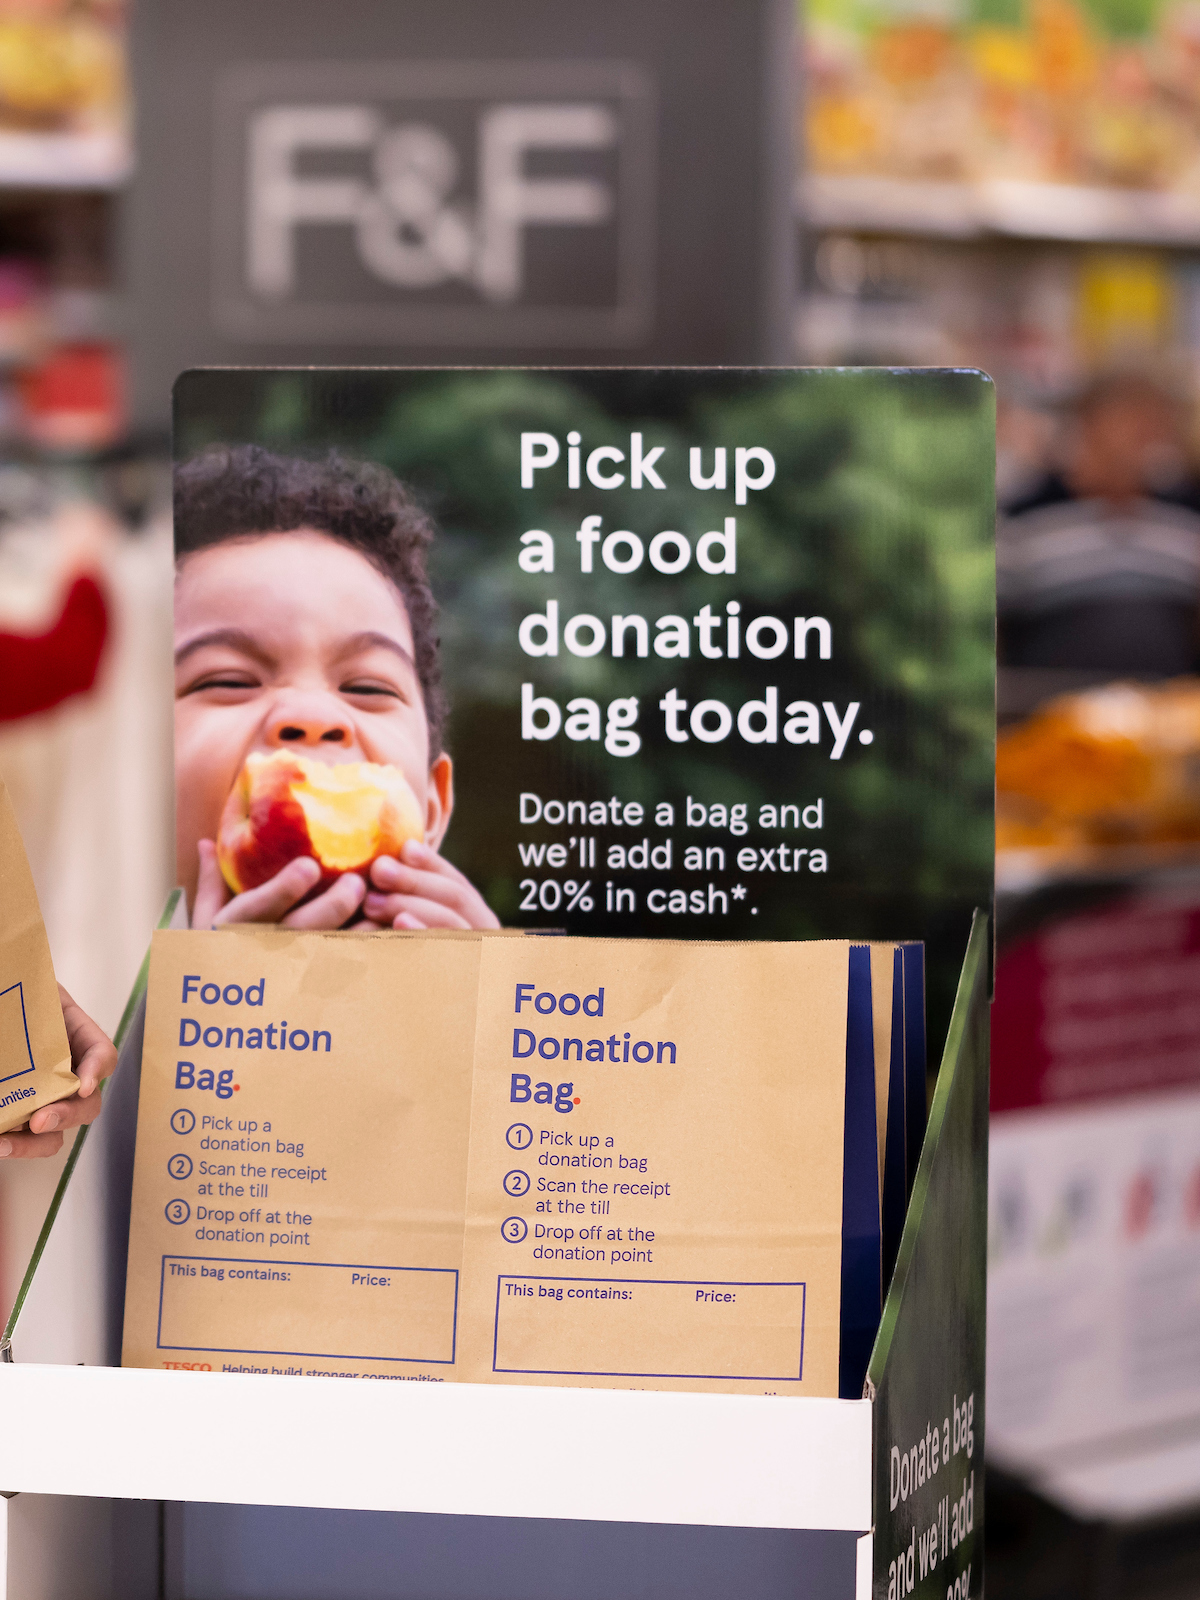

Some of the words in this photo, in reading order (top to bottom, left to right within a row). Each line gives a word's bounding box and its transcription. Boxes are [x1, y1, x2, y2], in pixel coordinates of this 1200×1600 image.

[248, 104, 614, 298] F&F
[520, 430, 667, 490] Pick
[689, 446, 776, 506] up
[518, 529, 555, 574] a
[575, 515, 737, 575] food
[518, 598, 832, 660] donation
[521, 682, 641, 757] bag
[659, 686, 874, 760] today.
[519, 792, 644, 826] Donate
[654, 802, 674, 827] a
[686, 795, 749, 836] bag
[758, 797, 823, 829] and
[517, 836, 595, 868] we'll
[606, 838, 672, 870] add
[683, 846, 725, 871] an
[736, 843, 828, 873] extra
[519, 878, 594, 912] 20%
[606, 880, 635, 912] in
[181, 974, 266, 1007] Food
[514, 983, 605, 1017] Food
[178, 1018, 332, 1053] Donation
[512, 1028, 677, 1064] Donation
[174, 1061, 241, 1100] Bag.
[509, 1073, 581, 1114] Bag.
[201, 1115, 233, 1131] Pick
[238, 1120, 258, 1135] up
[262, 1121, 272, 1133] a
[200, 1136, 271, 1153] donation
[276, 1139, 305, 1158] bag
[540, 1130, 573, 1146] Pick
[579, 1135, 600, 1151] up
[604, 1136, 614, 1148] a
[198, 1160, 236, 1177] Scan
[240, 1163, 267, 1178] the
[271, 1165, 328, 1184] receipt
[538, 1151, 613, 1168] donation
[618, 1154, 648, 1173] bag
[197, 1182, 214, 1196] at
[218, 1182, 245, 1197] the
[249, 1183, 268, 1198] till
[536, 1177, 576, 1193] Scan
[581, 1179, 609, 1194] the
[613, 1181, 671, 1199] receipt
[196, 1205, 235, 1225] Drop
[238, 1208, 262, 1223] off
[265, 1210, 282, 1224] at
[285, 1210, 313, 1226] the
[535, 1199, 553, 1213] at
[557, 1199, 586, 1214] the
[590, 1200, 610, 1215] till
[195, 1226, 265, 1243] donation
[269, 1230, 311, 1248] point
[534, 1223, 575, 1243] Drop
[579, 1225, 603, 1240] off
[606, 1227, 623, 1241] at
[627, 1227, 655, 1242] the
[532, 1244, 606, 1261] donation
[610, 1247, 653, 1265] point
[168, 1263, 197, 1277] This
[200, 1265, 225, 1281] bag
[228, 1268, 291, 1282] contains:
[351, 1273, 391, 1287] Price:
[505, 1283, 534, 1297] This
[538, 1284, 564, 1301] bag
[567, 1287, 633, 1300] contains:
[695, 1289, 736, 1303] Price:
[890, 1421, 940, 1512] Donate
[942, 1418, 950, 1465] a
[953, 1391, 974, 1458] bag
[888, 1526, 916, 1600] and
[952, 1470, 975, 1550] add
